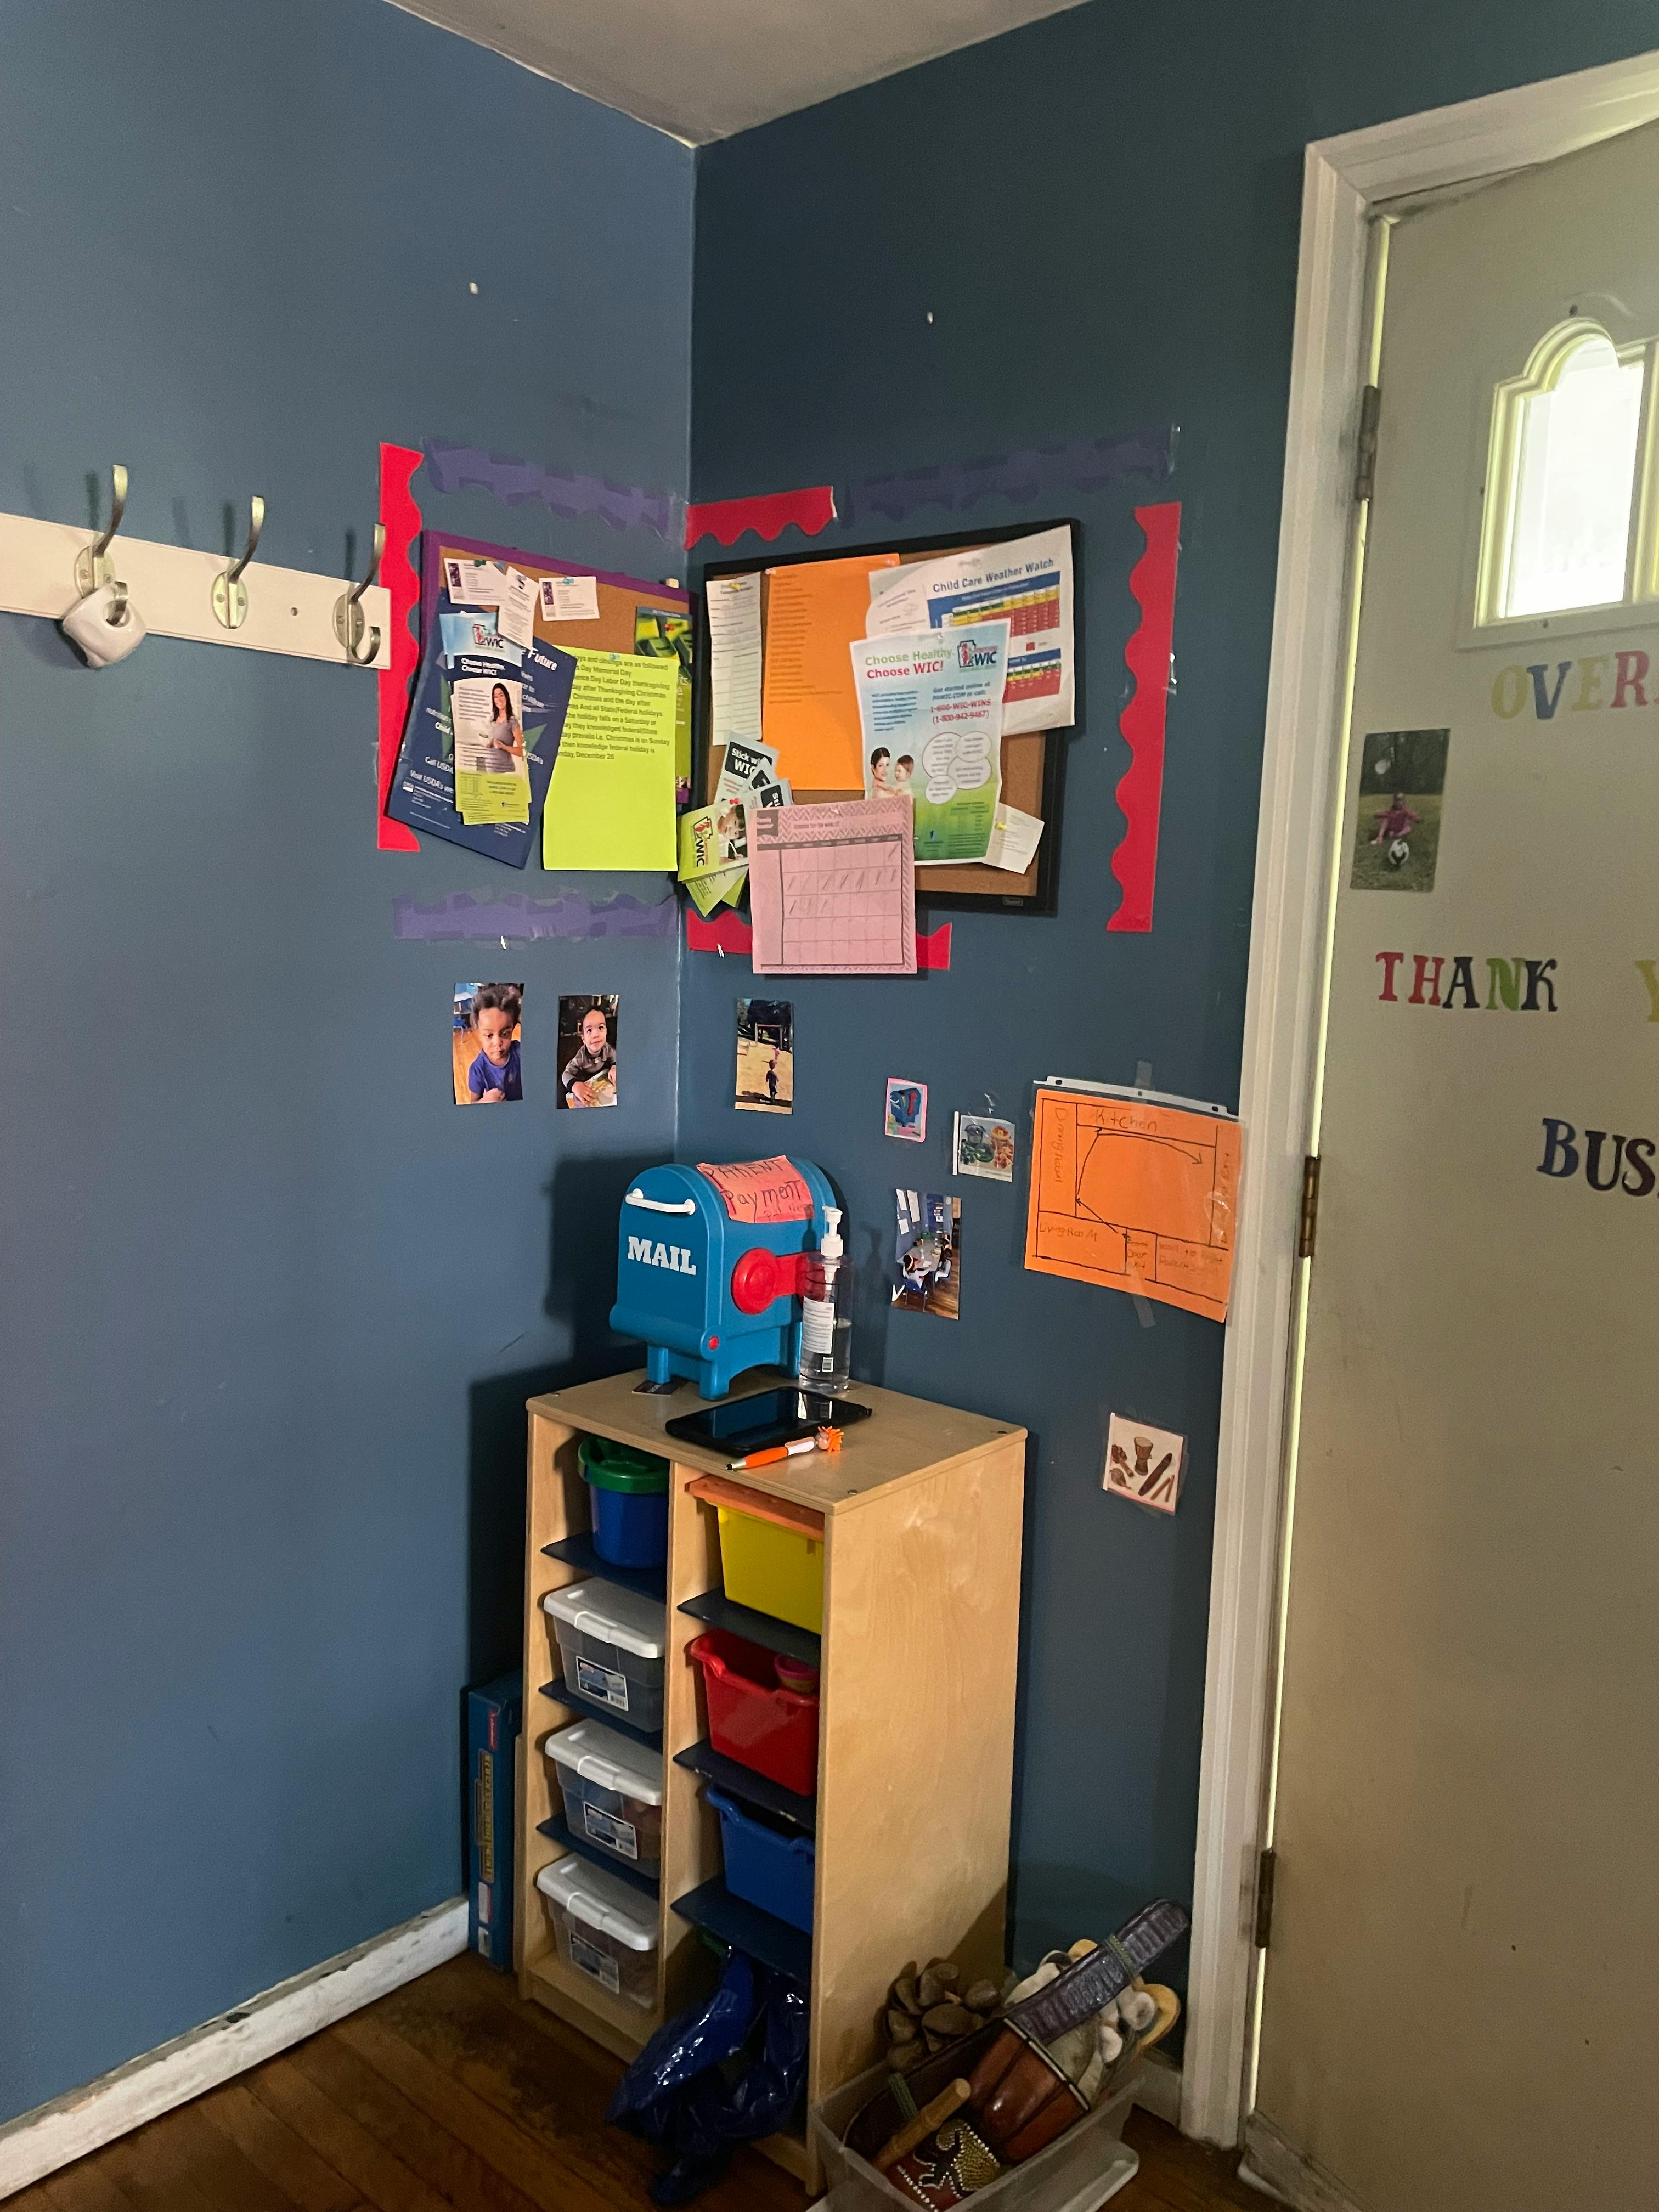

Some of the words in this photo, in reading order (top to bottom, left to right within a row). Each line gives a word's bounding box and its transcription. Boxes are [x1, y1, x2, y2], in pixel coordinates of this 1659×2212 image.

[933, 579, 959, 593] Child
[962, 576, 983, 588] Care
[985, 567, 1022, 583] Weather
[1025, 558, 1053, 573] Watch
[487, 637, 504, 648] WIC
[528, 648, 557, 671] Future
[865, 653, 909, 666] Choose
[974, 651, 997, 666] WIC
[620, 669, 632, 678] Day
[867, 668, 910, 679] Choose
[913, 661, 944, 674] WIC!
[1491, 650, 1659, 720] OVER
[577, 713, 597, 721] holiday
[625, 717, 650, 726] Saturday
[606, 734, 634, 742] Christmas
[649, 737, 670, 746] Sunday
[576, 751, 606, 759] December
[732, 748, 749, 761] Stick
[696, 839, 704, 867] WIC
[1376, 952, 1558, 1012] THANK
[1536, 1118, 1659, 1197] BUS
[628, 1235, 696, 1276] MAIL
